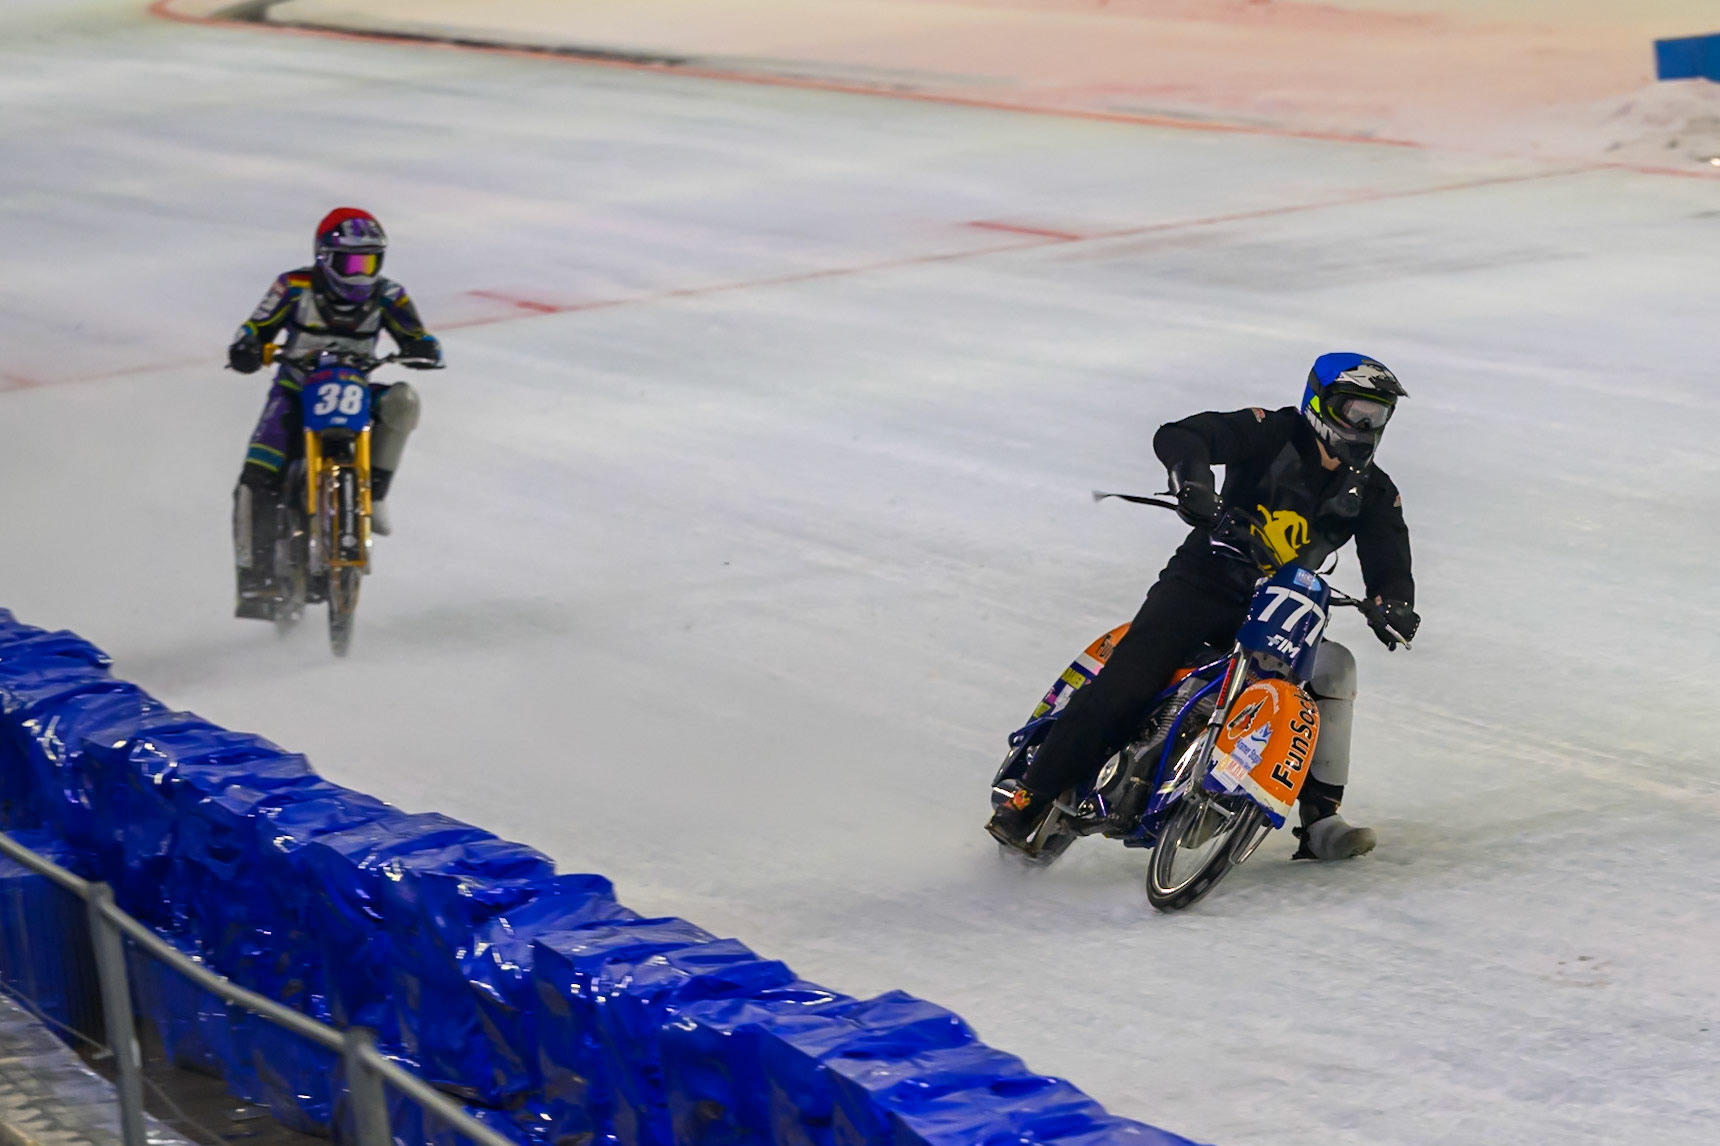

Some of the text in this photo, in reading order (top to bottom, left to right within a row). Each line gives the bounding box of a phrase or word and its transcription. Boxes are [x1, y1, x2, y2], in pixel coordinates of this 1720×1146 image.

[313, 383, 363, 416] 38
[1257, 585, 1326, 647] 777
[1267, 633, 1301, 659] FIM
